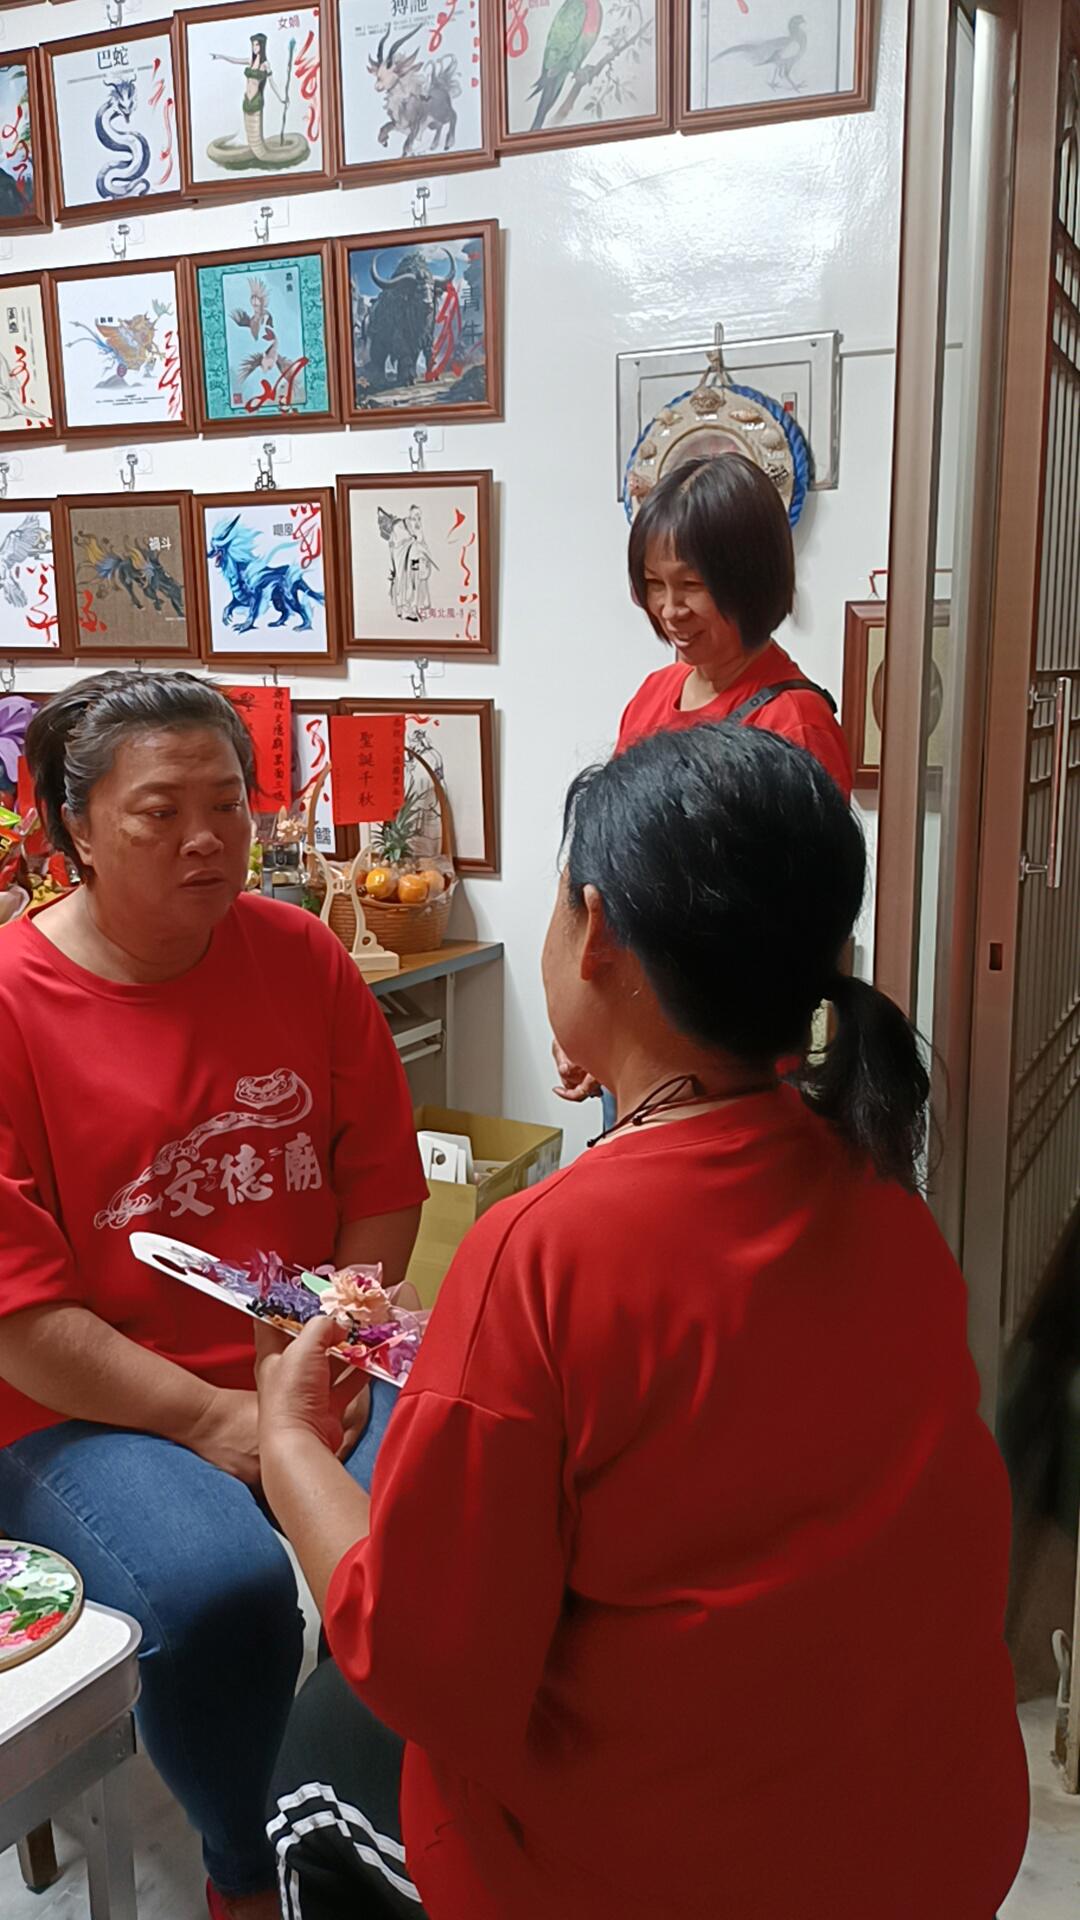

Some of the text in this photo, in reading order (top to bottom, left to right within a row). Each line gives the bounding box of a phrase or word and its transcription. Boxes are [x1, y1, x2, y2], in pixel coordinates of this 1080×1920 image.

[97, 46, 129, 69] 巴蛇
[461, 284, 483, 345] 青牛
[358, 731, 375, 812] 聖誕千秋
[164, 1131, 322, 1217] 文德廟
